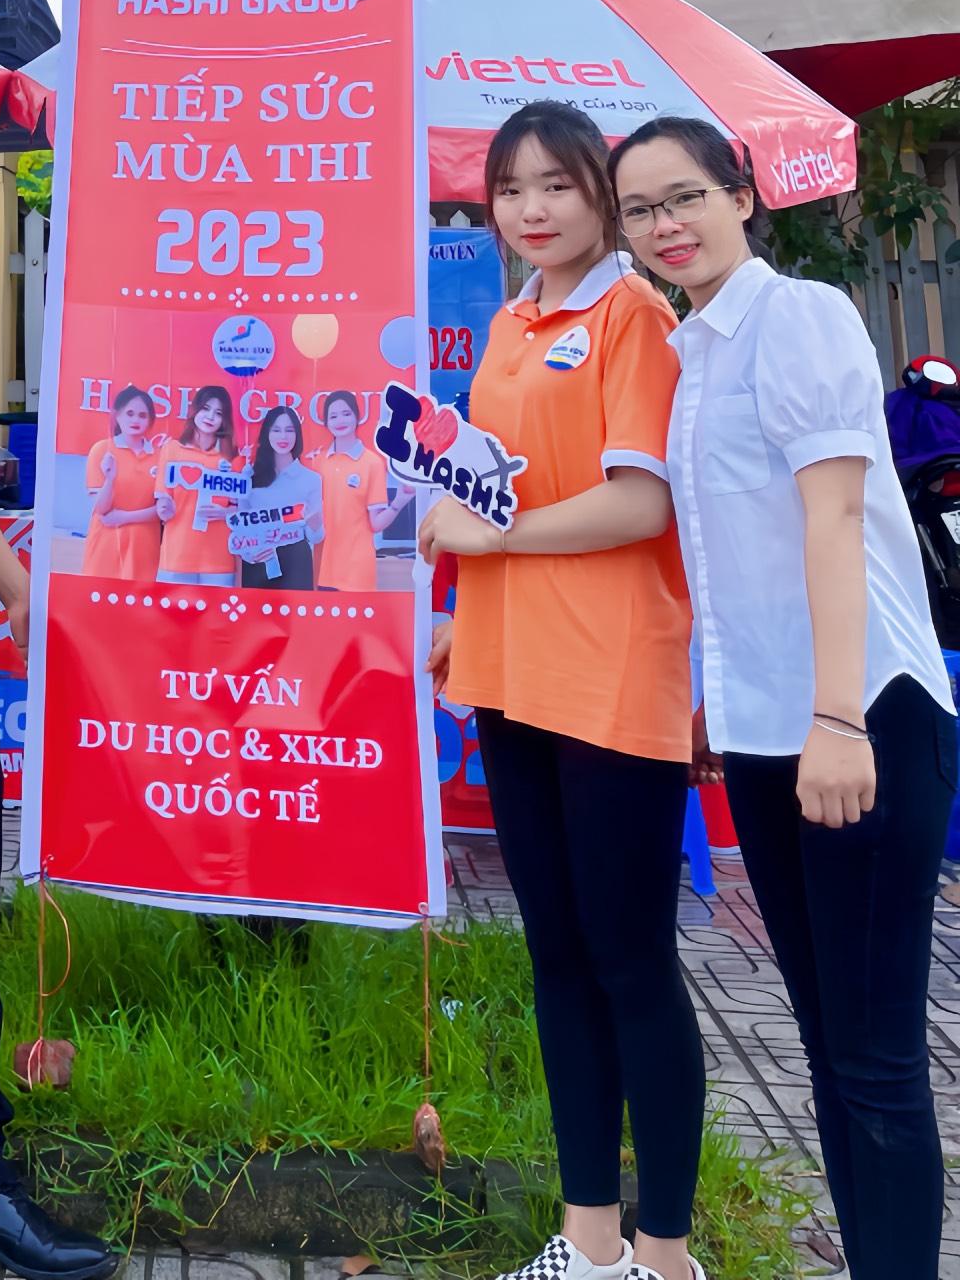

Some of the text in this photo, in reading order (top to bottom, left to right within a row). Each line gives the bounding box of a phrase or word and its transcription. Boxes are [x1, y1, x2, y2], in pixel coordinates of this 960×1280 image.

[112, 67, 375, 122] TIẾP SỨC
[426, 52, 646, 88] viettel
[112, 133, 374, 183] MÙA THI
[769, 145, 844, 195] viettel
[155, 208, 324, 277] 2023
[169, 465, 247, 494] I HASHI
[375, 385, 513, 526] I HASHI
[161, 662, 303, 707] TƯ VẤN
[78, 718, 383, 769] DU HỌC & XKLĐ
[144, 773, 321, 824] QUỐC TẾ
